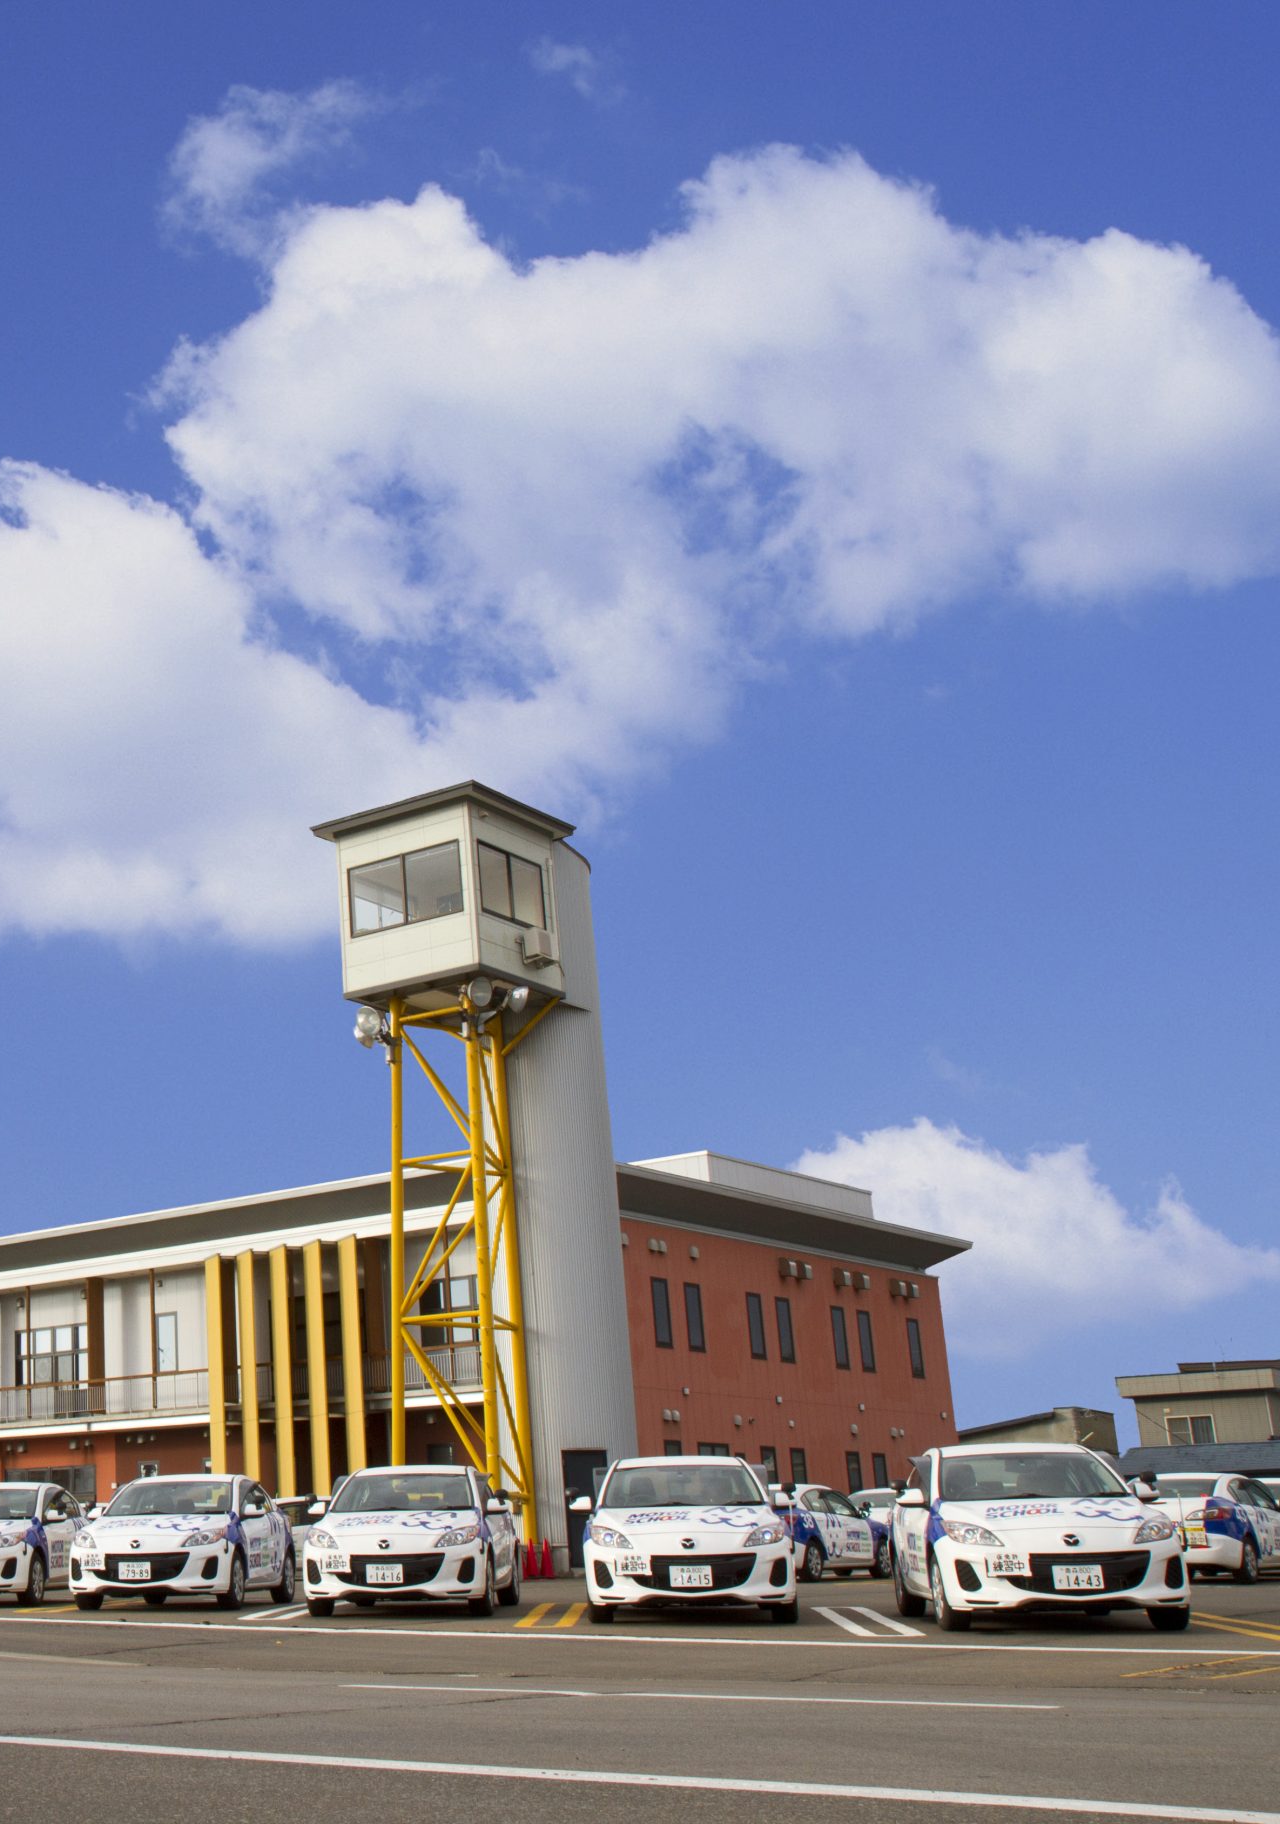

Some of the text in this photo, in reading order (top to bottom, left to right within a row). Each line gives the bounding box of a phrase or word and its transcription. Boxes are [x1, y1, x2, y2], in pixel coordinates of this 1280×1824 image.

[985, 1503, 1059, 1513] MOTOR
[628, 1511, 690, 1519] MOTOR
[985, 1508, 1065, 1519] SCHOOL
[623, 1515, 690, 1524] SCHOOL
[801, 1513, 815, 1529] 38
[621, 1561, 647, 1571] 練習中
[993, 1560, 1025, 1572] 練習中
[125, 1569, 149, 1578] 79-89
[376, 1572, 401, 1582] 14-16
[680, 1574, 710, 1585] 14-15
[1066, 1574, 1102, 1587] 14-43
